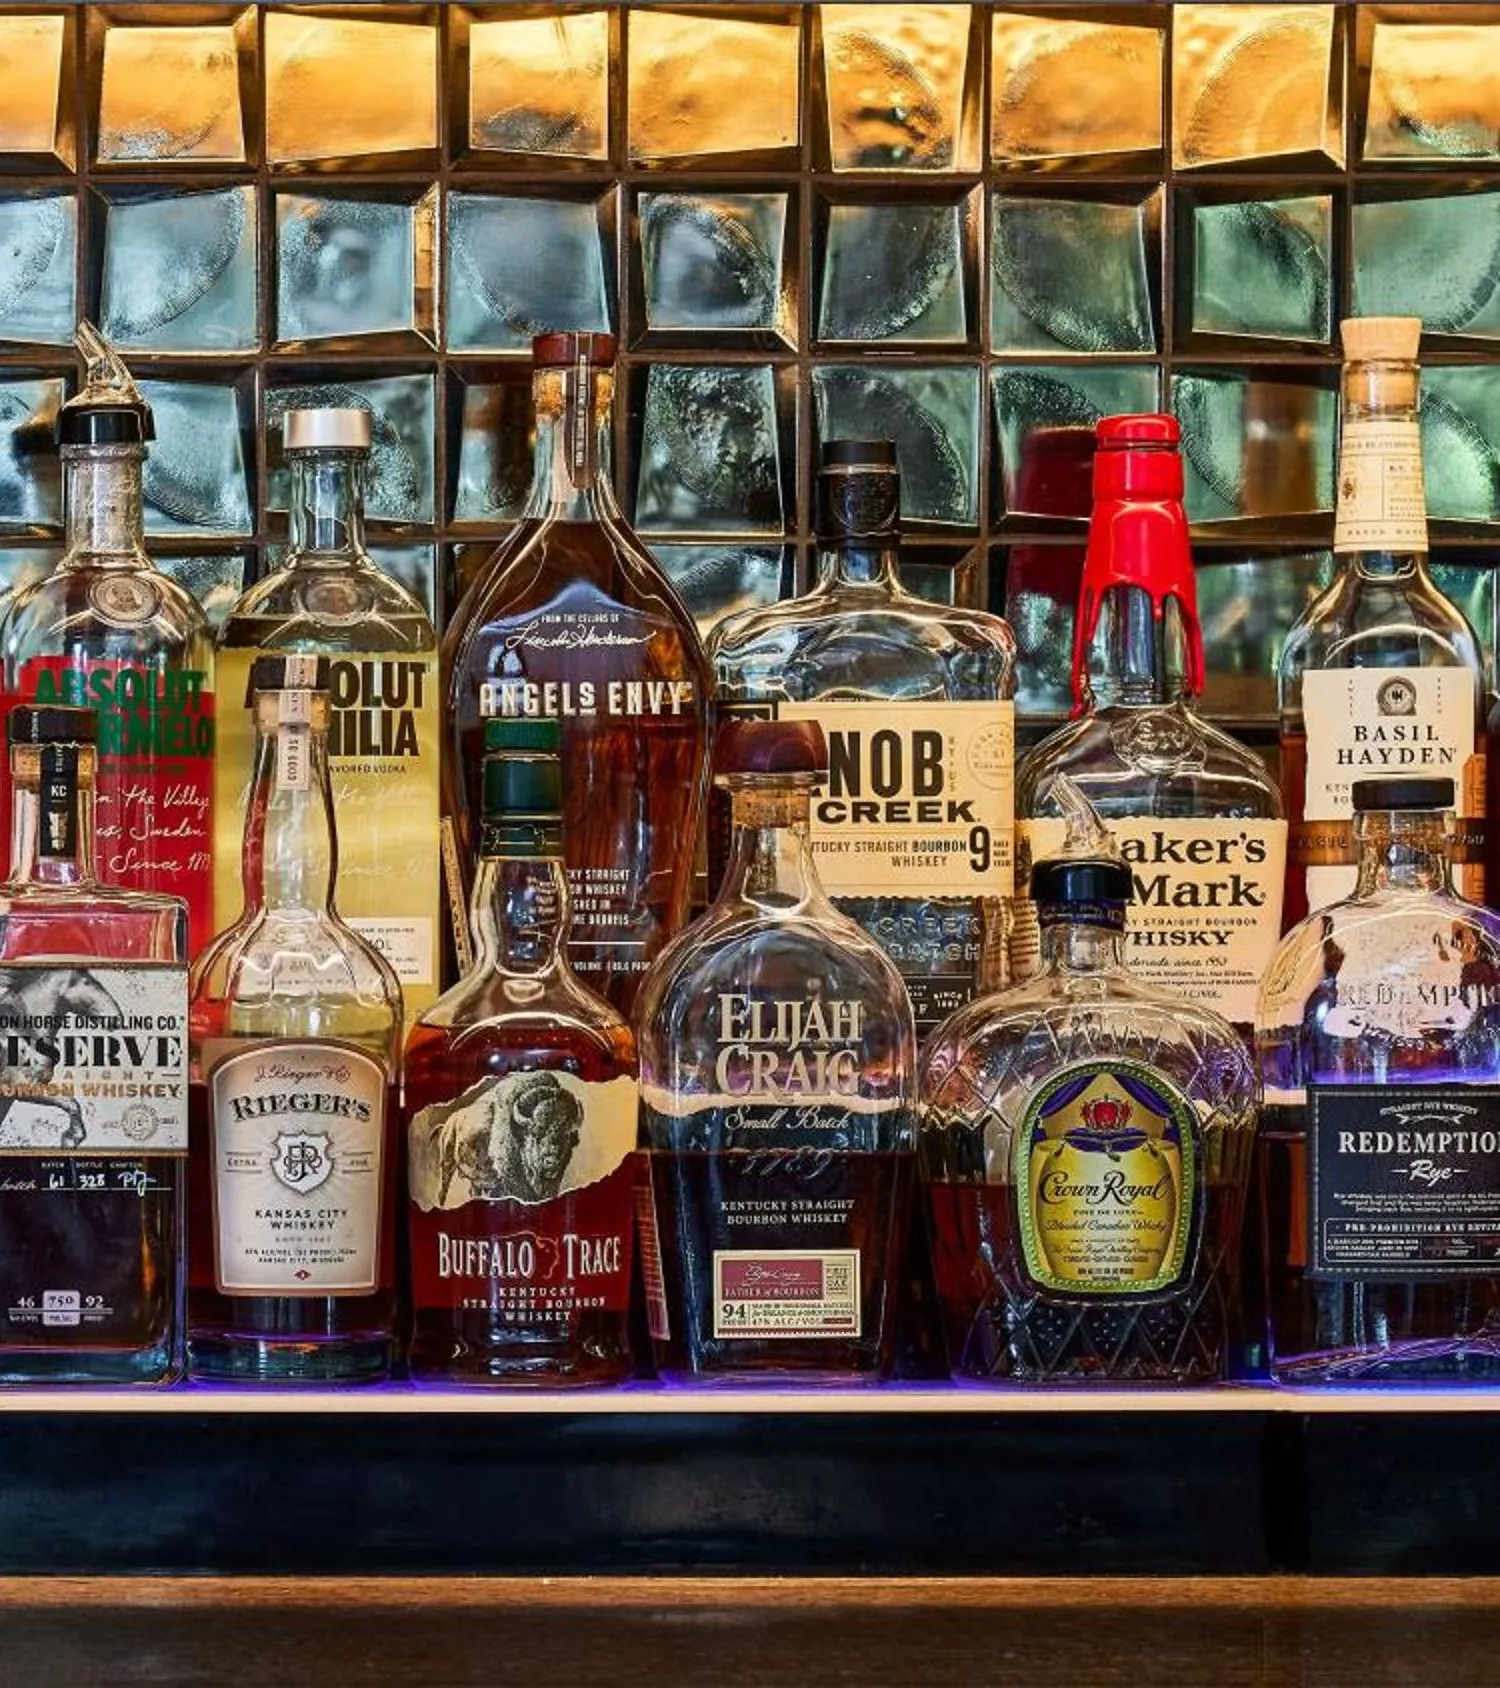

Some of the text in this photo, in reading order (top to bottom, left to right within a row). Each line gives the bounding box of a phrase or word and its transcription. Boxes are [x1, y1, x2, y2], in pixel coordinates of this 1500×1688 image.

[330, 660, 427, 709] OLUT
[607, 680, 694, 716] ENVY
[1353, 729, 1441, 745] BASIL
[828, 729, 944, 799] NOB
[1336, 752, 1453, 770] HAYDEN
[51, 784, 67, 797] KC
[816, 800, 974, 824] CREEK
[129, 813, 206, 841] Sweden
[853, 840, 967, 854] STRAIGHT BOURBON
[969, 825, 990, 873] 9
[1119, 830, 1267, 864] aker's
[109, 847, 182, 873] Since
[890, 856, 947, 868] WHISKEY
[585, 869, 630, 881] STRAIGHT
[586, 883, 627, 895] WHISKEY
[1129, 874, 1263, 908] Mark
[588, 913, 629, 925] BARRELS
[1143, 918, 1258, 926] STRAIGHT BOURBON
[27, 1015, 70, 1031] HORSE
[74, 1015, 152, 1031] DISTILLING
[717, 993, 862, 1051] ELIJAH
[715, 1045, 861, 1098] CRAIG
[80, 1083, 182, 1099] WHISKEY
[229, 1093, 372, 1123] RIEGER'S
[724, 1104, 850, 1130] Small Batch
[1408, 1159, 1455, 1188] Rye
[1040, 1169, 1172, 1206] Crown Royal
[720, 1199, 855, 1211] KENTUCKY STRAIGHT
[255, 1209, 347, 1219] KANSAS CITY
[726, 1213, 847, 1225] BOURBON WHISKEY
[269, 1221, 335, 1231] WHISKEY
[437, 1232, 621, 1279] BUFFALO TRACE
[499, 1285, 576, 1297] KENTUCKY
[724, 1286, 819, 1298] FATHER BOURBON
[49, 1295, 75, 1307] 750
[85, 1295, 104, 1309] 92
[462, 1296, 605, 1309] STRAIGHT BOURBON
[504, 1310, 571, 1321] WHISKEY
[722, 1303, 747, 1318] 94
